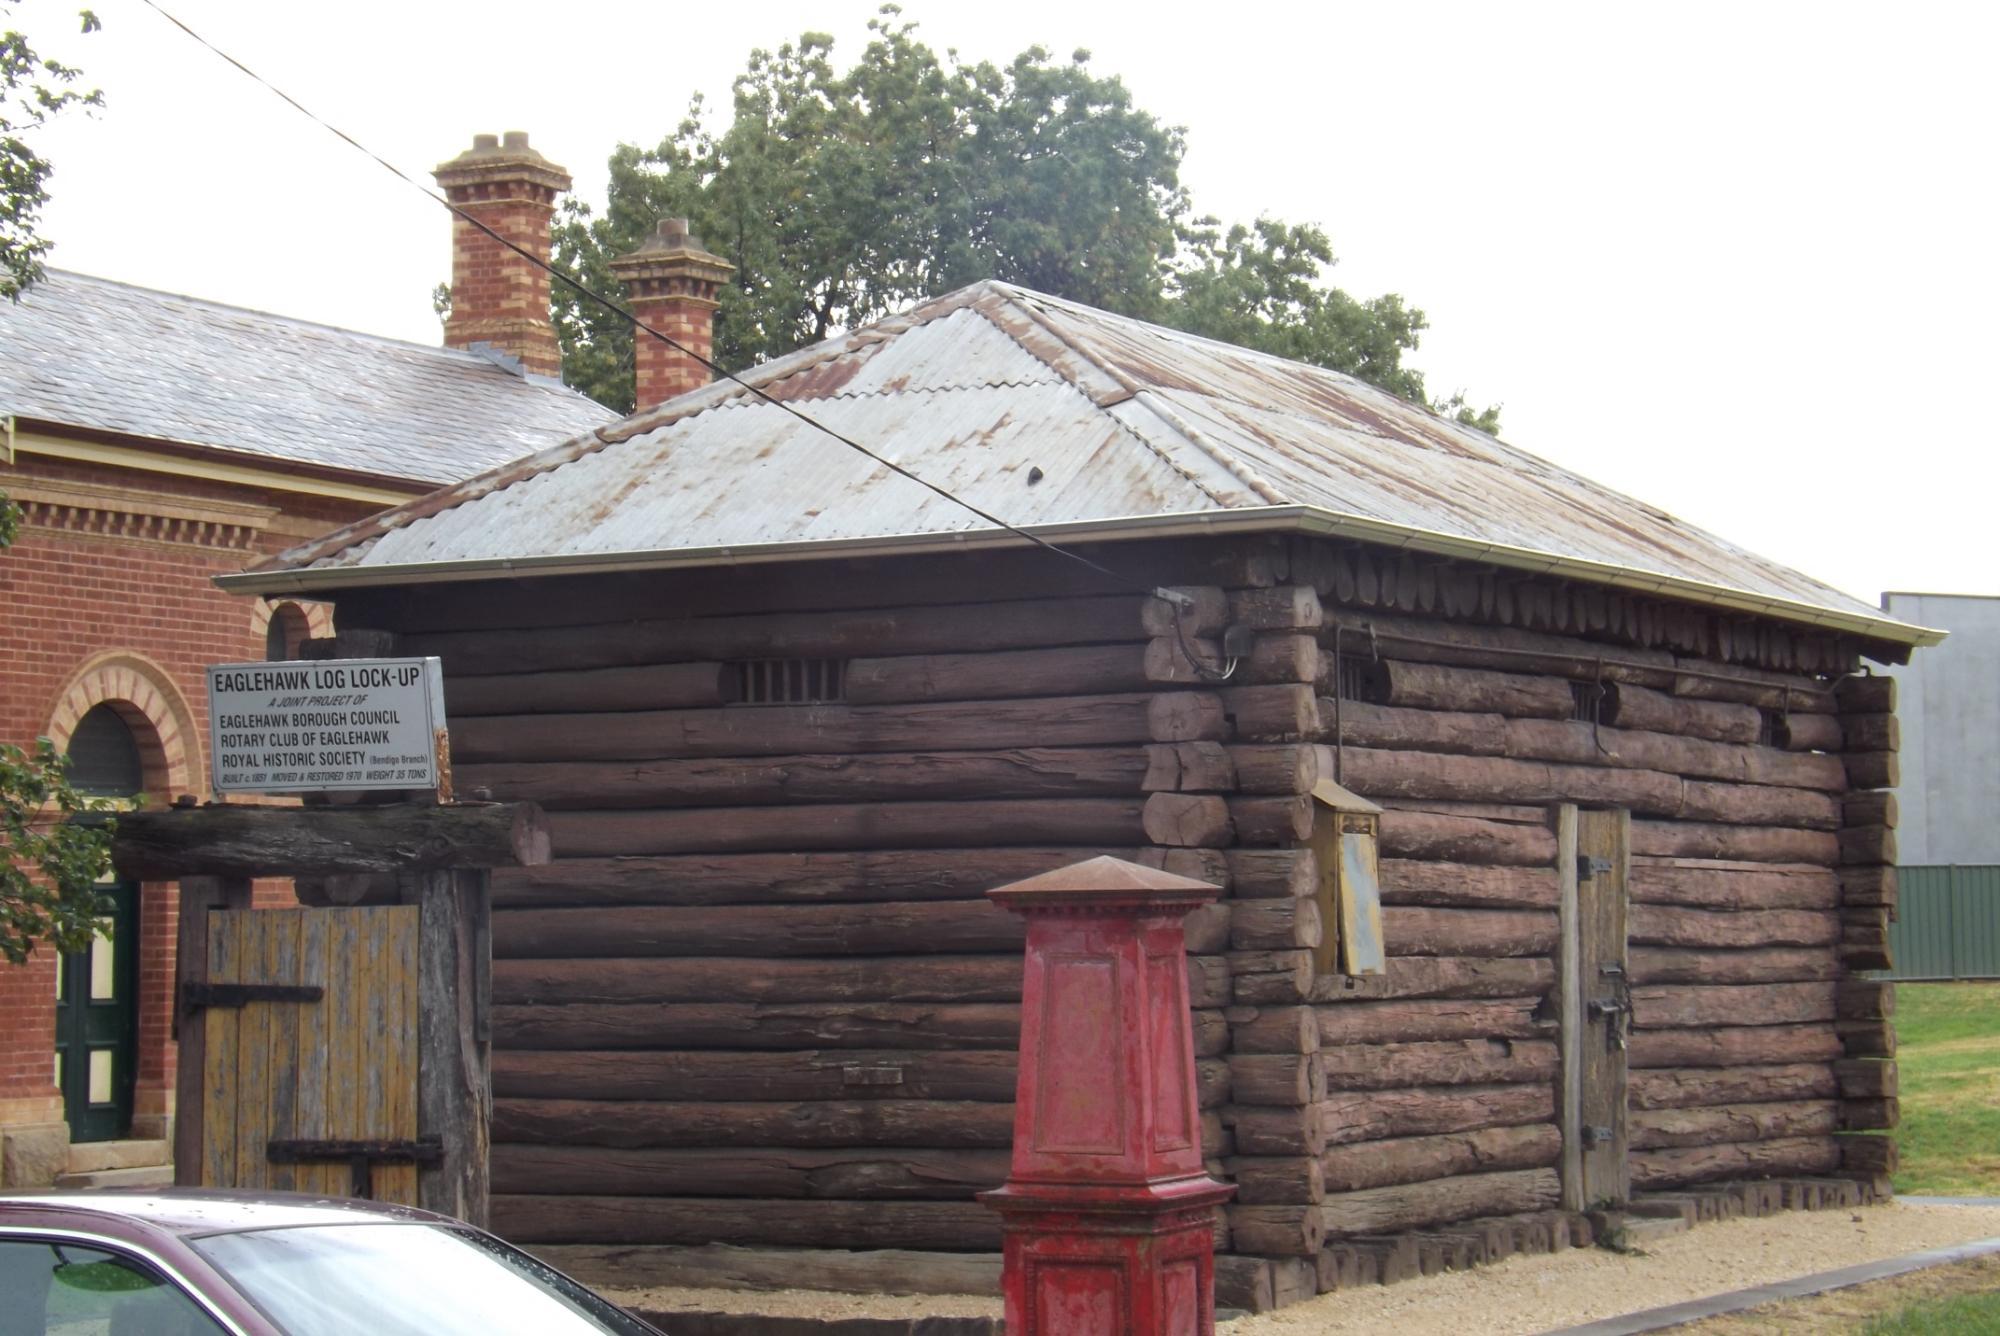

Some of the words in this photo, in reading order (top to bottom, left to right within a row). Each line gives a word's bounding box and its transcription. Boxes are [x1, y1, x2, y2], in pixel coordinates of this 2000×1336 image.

[215, 672, 311, 692] EAGLEHAWK
[315, 670, 345, 689] LOG
[351, 667, 419, 688] LOCK-UP
[267, 698, 276, 707] A
[277, 697, 307, 707] JOINT
[307, 695, 352, 706] PROJECT
[353, 695, 368, 705] OF
[220, 714, 289, 728] EAGLEHAWK
[293, 712, 347, 726] BOROUGH
[351, 711, 400, 725] COUNCIL
[221, 734, 265, 748] ROTARY
[270, 733, 299, 747] CLUB
[302, 732, 316, 746] OF
[320, 731, 390, 745] EAGLEHAWK
[222, 754, 260, 768] ROYAL
[264, 753, 316, 767] HISTORIC
[319, 752, 365, 765] SOCIETY
[370, 756, 400, 765] (Bendigo
[401, 755, 428, 764] Branch)
[222, 774, 242, 783] BUILT
[271, 773, 297, 782] MOVED
[307, 772, 344, 781] RESTORED
[346, 771, 361, 781] 1970
[366, 770, 394, 780] WEIGHT
[396, 770, 405, 779] 35
[407, 769, 426, 779] TONS
